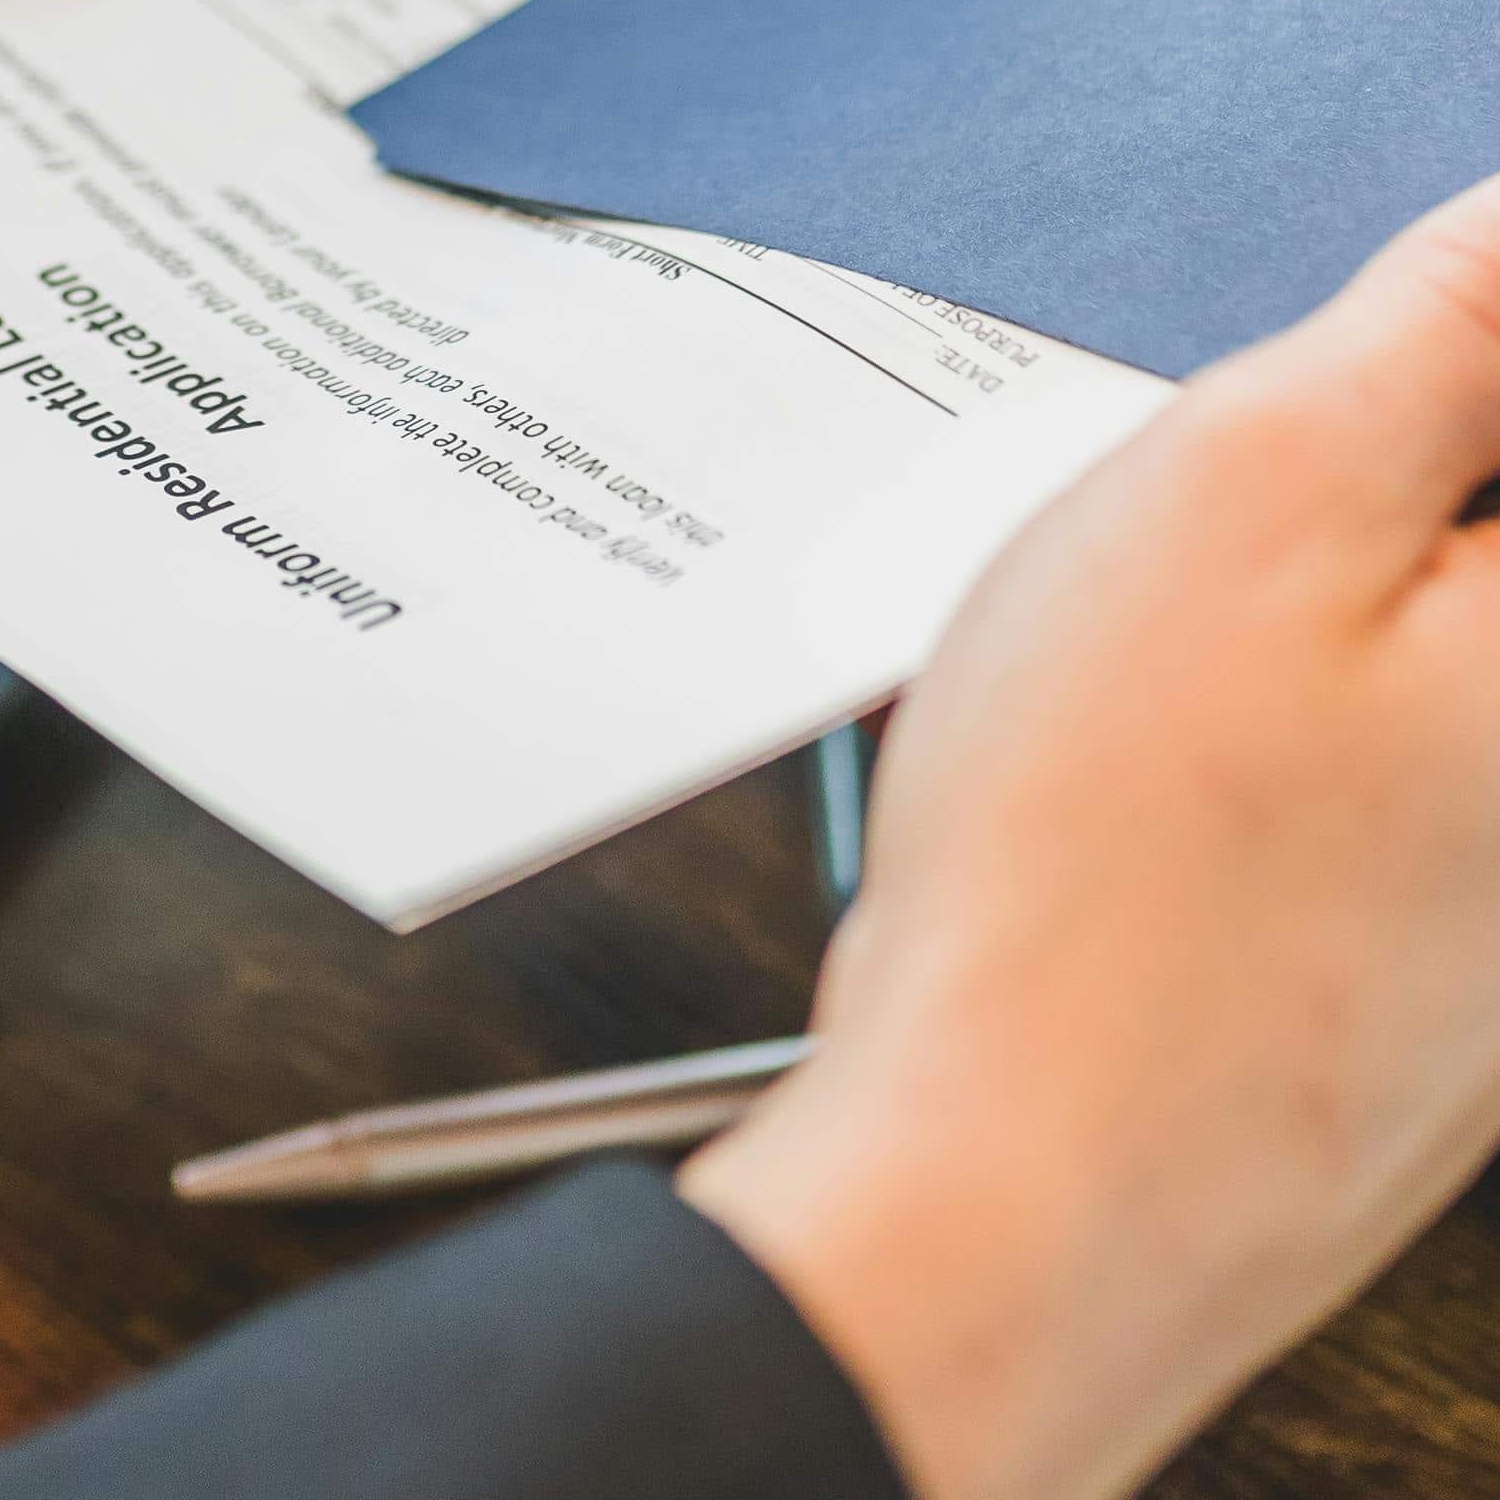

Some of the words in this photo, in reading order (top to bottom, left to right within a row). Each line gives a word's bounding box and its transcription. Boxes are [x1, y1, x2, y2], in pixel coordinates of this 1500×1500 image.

[630, 244, 690, 280] Short
[228, 312, 270, 337] on
[282, 300, 410, 371] additional
[370, 297, 470, 346] directed
[36, 262, 266, 434] Application
[260, 336, 401, 424] information
[400, 364, 464, 393] each
[391, 412, 439, 441] the
[461, 383, 549, 438] others,
[431, 431, 555, 510] complete
[540, 434, 609, 480] with
[604, 473, 673, 520] loan
[537, 504, 609, 540] and
[220, 515, 403, 631] Uniform
